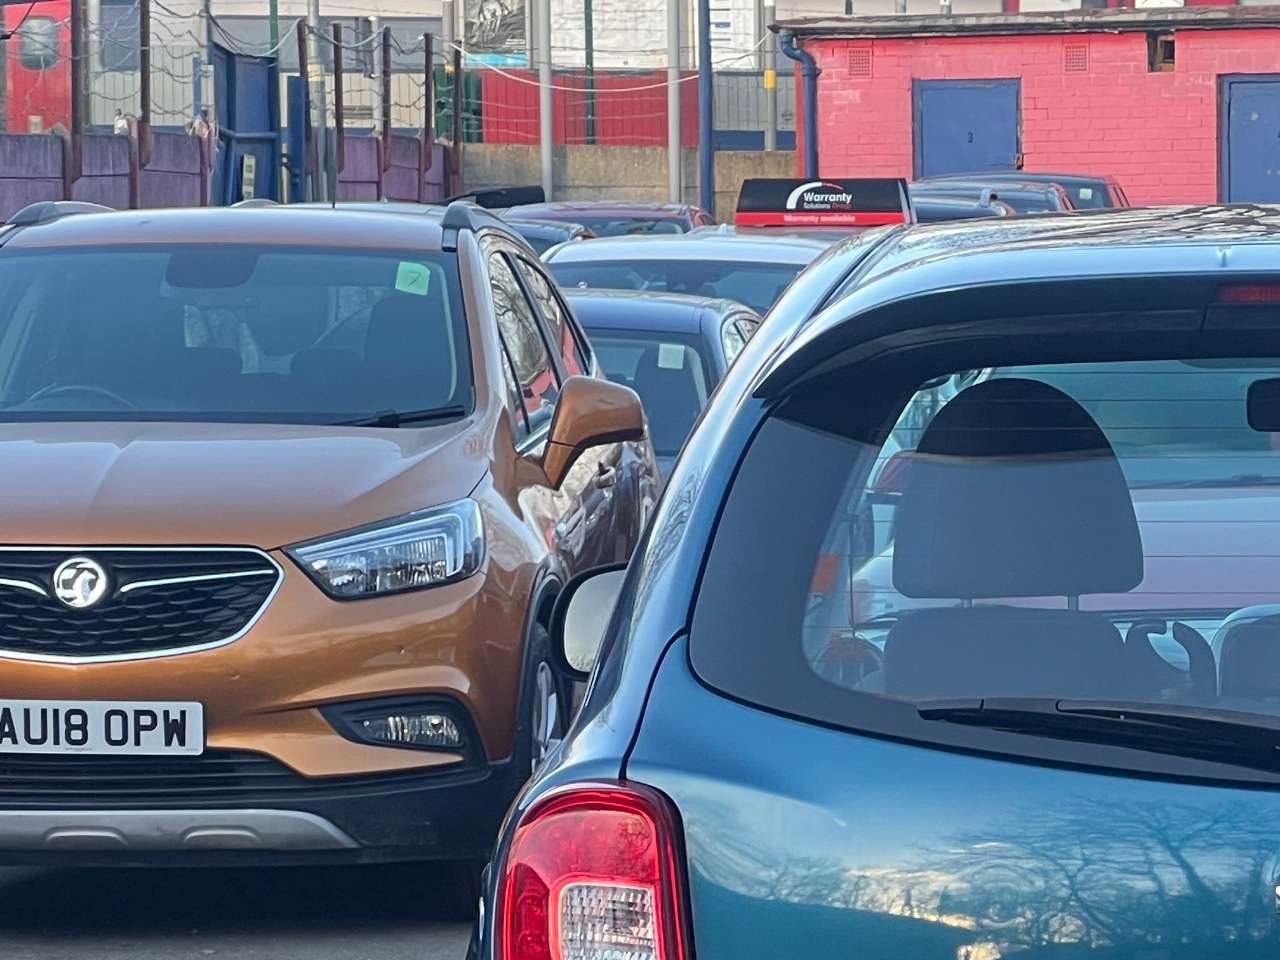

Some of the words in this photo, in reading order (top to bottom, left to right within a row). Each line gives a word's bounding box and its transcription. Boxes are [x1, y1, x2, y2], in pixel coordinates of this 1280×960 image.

[967, 131, 975, 143] 3
[803, 192, 852, 204] Warranty
[0, 707, 89, 746] AU18
[104, 709, 187, 747] OPW
